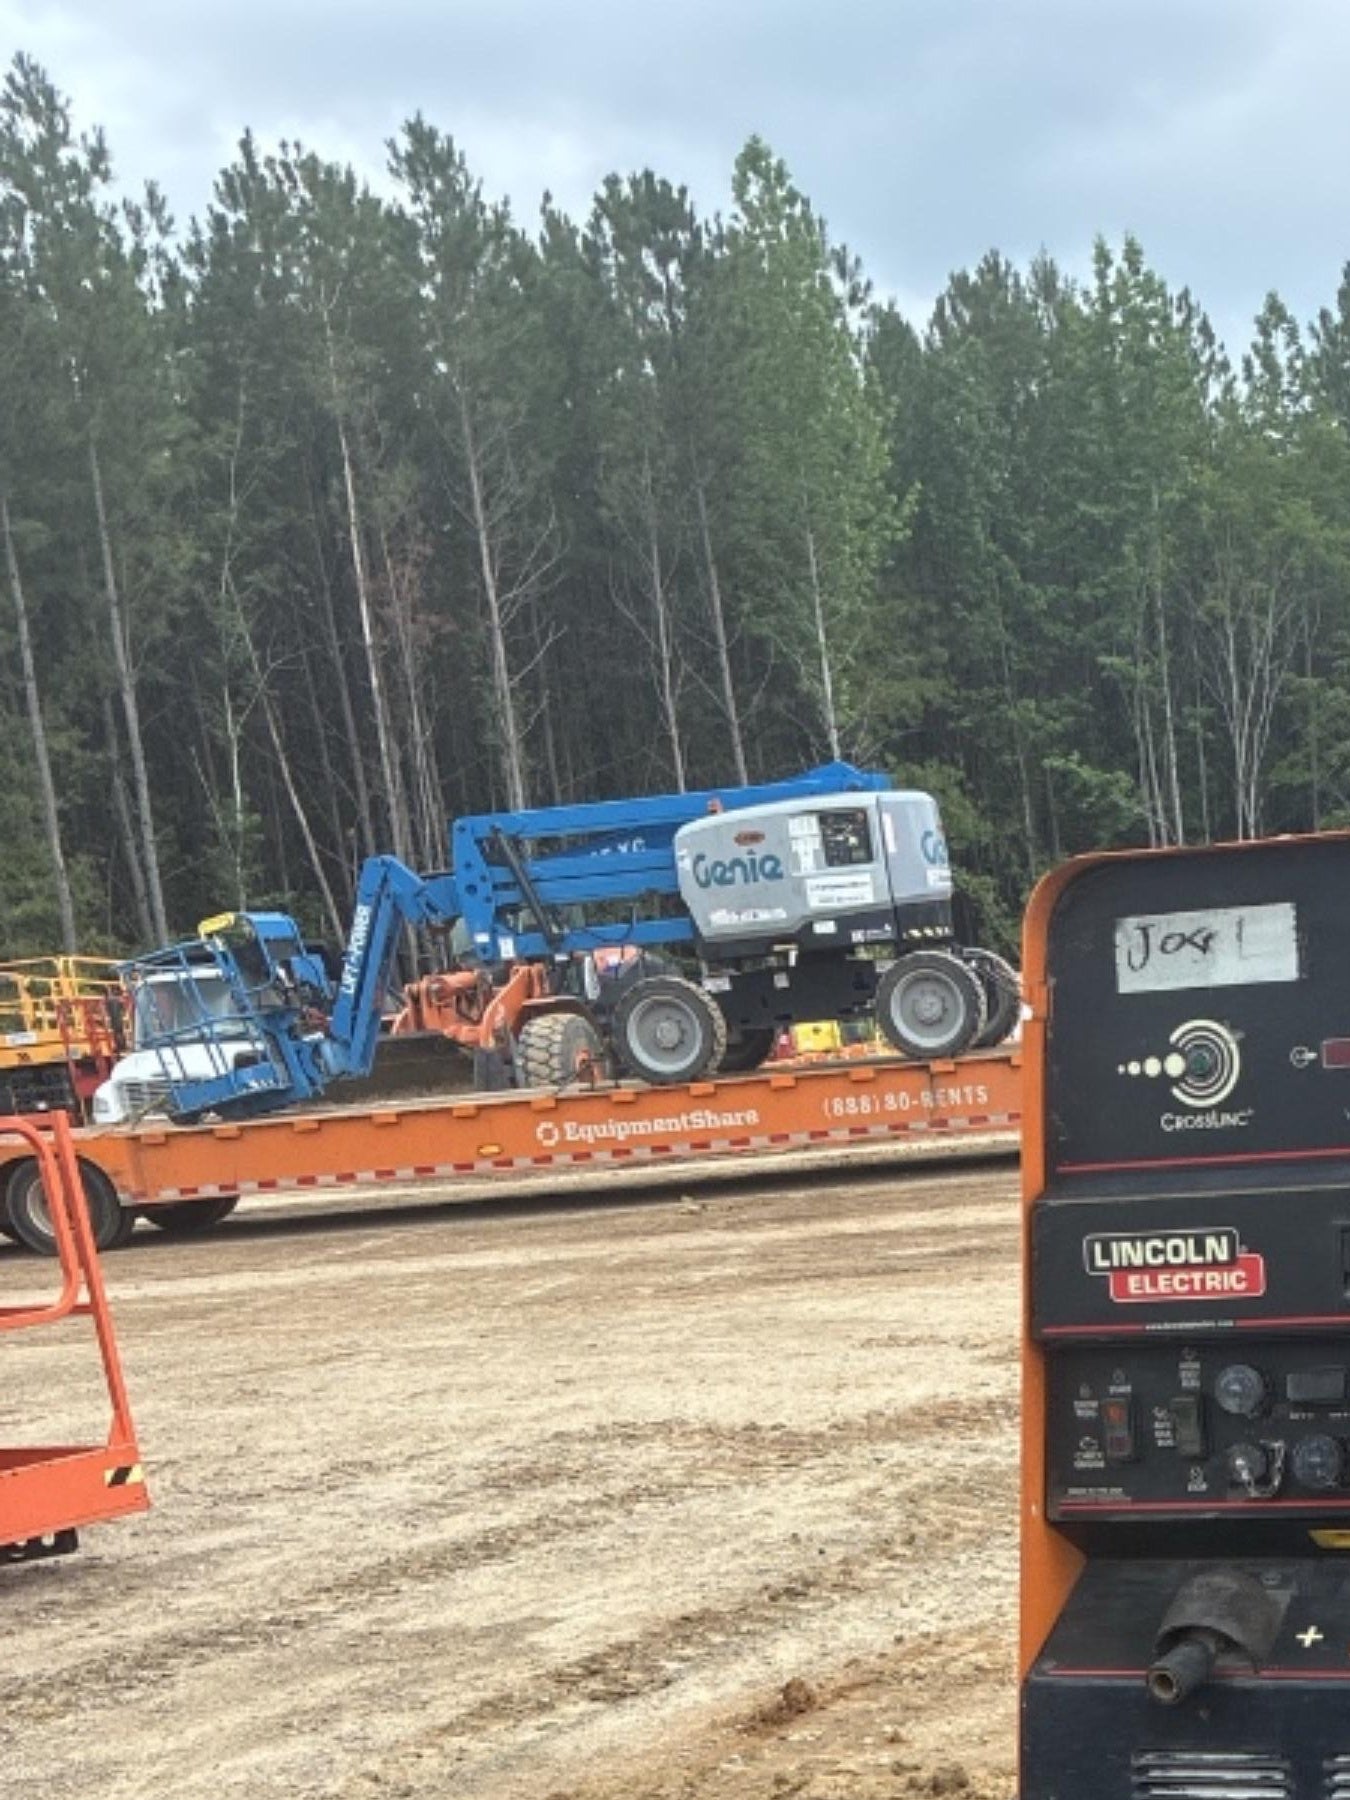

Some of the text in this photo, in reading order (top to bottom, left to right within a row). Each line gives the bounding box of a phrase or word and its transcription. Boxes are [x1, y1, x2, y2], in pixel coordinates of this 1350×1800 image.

[692, 849, 784, 889] Genie
[563, 1109, 760, 1143] EquipmentShare
[1094, 1235, 1229, 1268] LINCOLN
[1127, 1271, 1248, 1295] ELECTRIC
